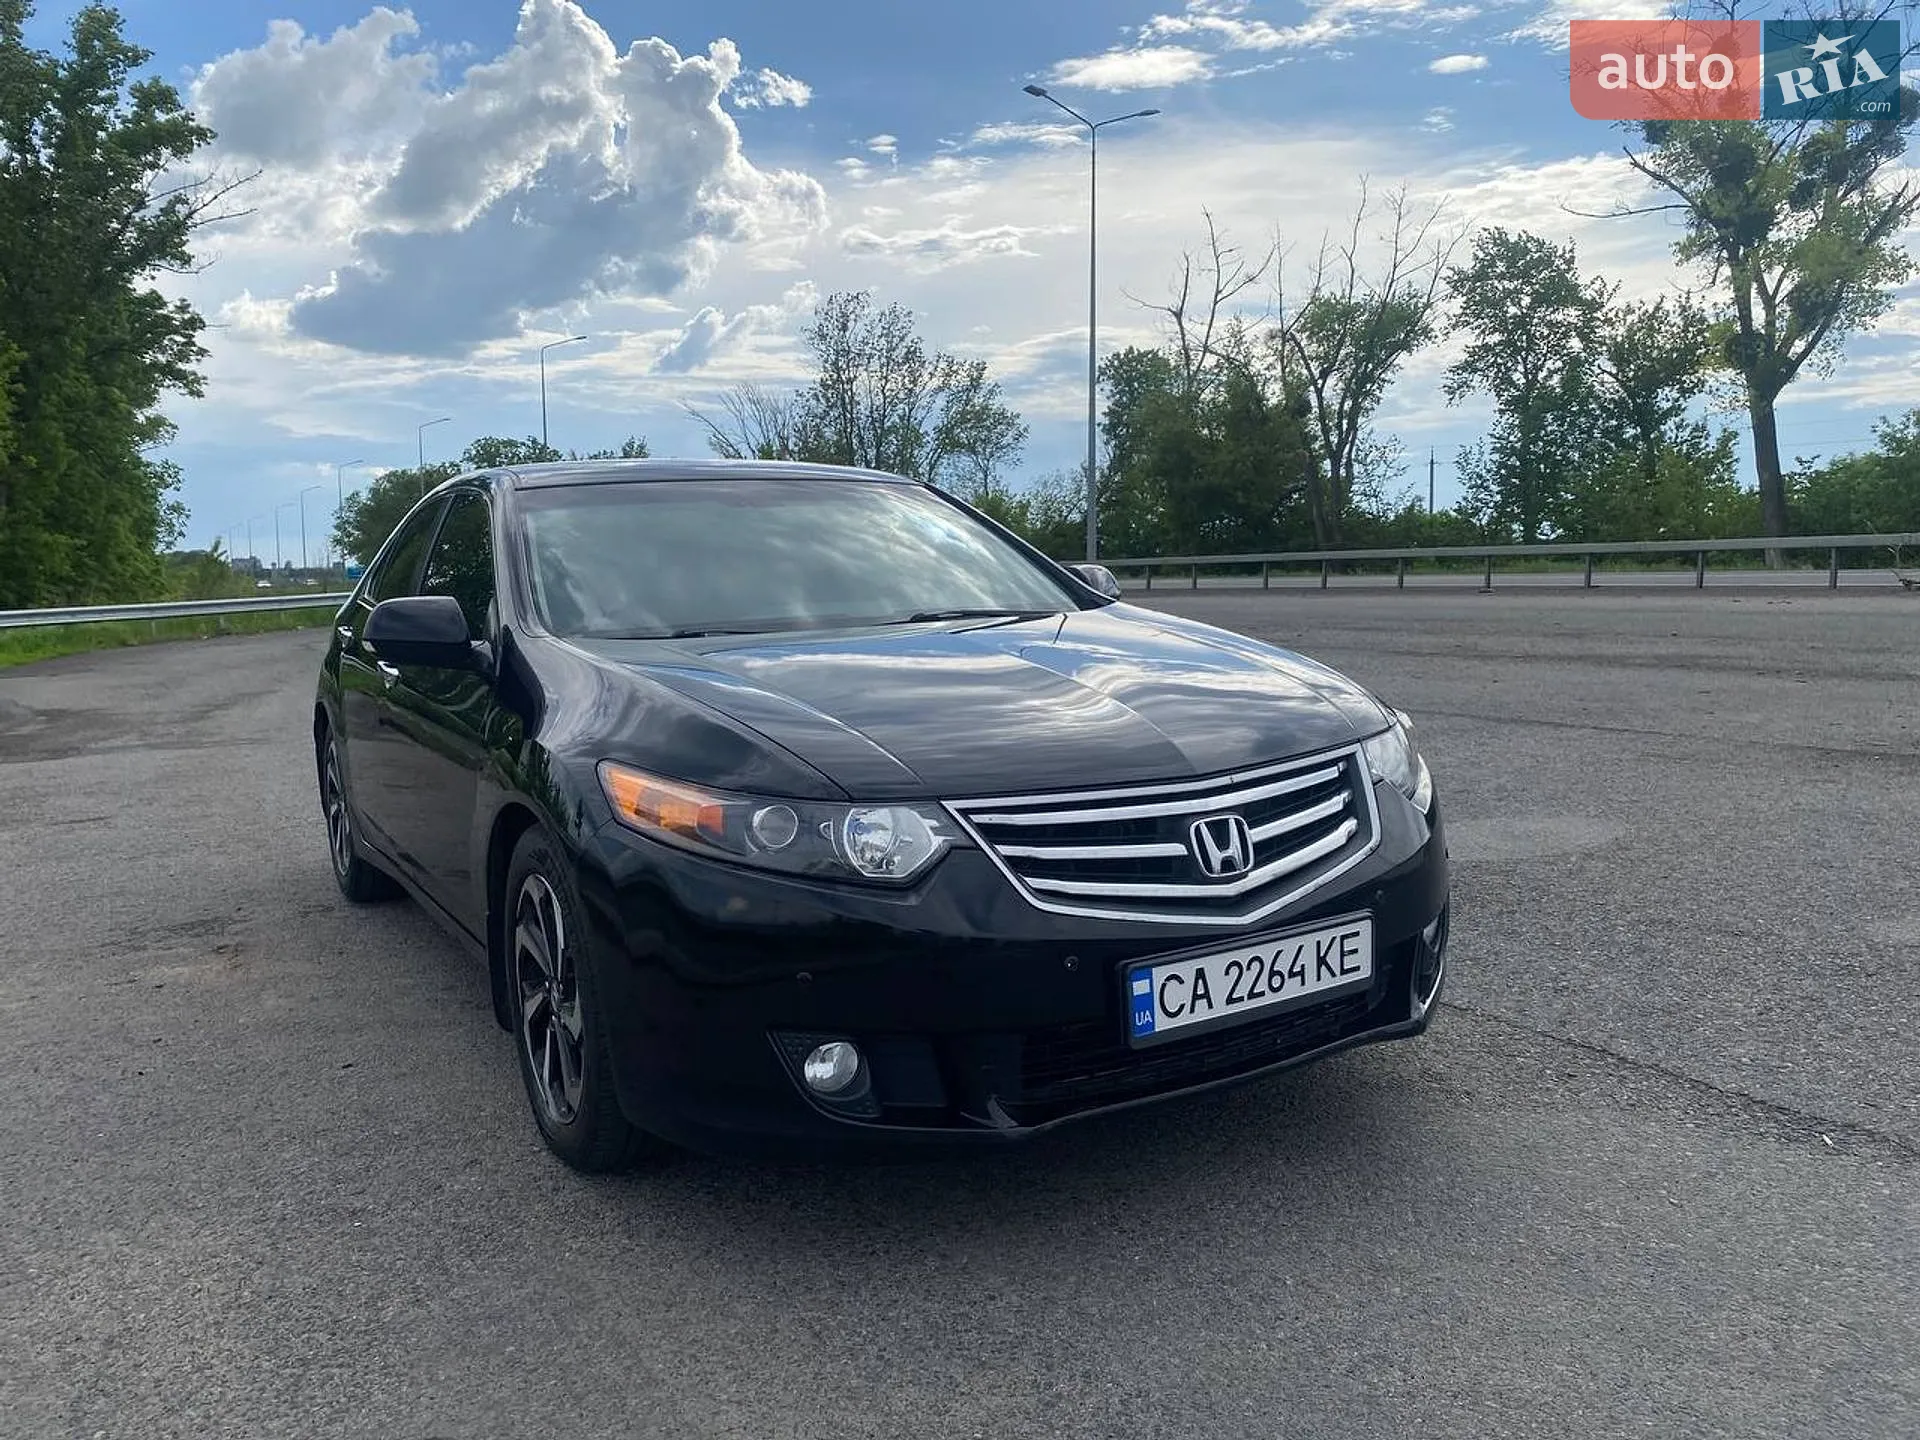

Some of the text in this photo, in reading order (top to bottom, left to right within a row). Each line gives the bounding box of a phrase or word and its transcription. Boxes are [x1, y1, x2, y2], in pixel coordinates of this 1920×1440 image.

[1159, 930, 1361, 1019] CA 2264 KE
[1134, 1010, 1152, 1027] UA
